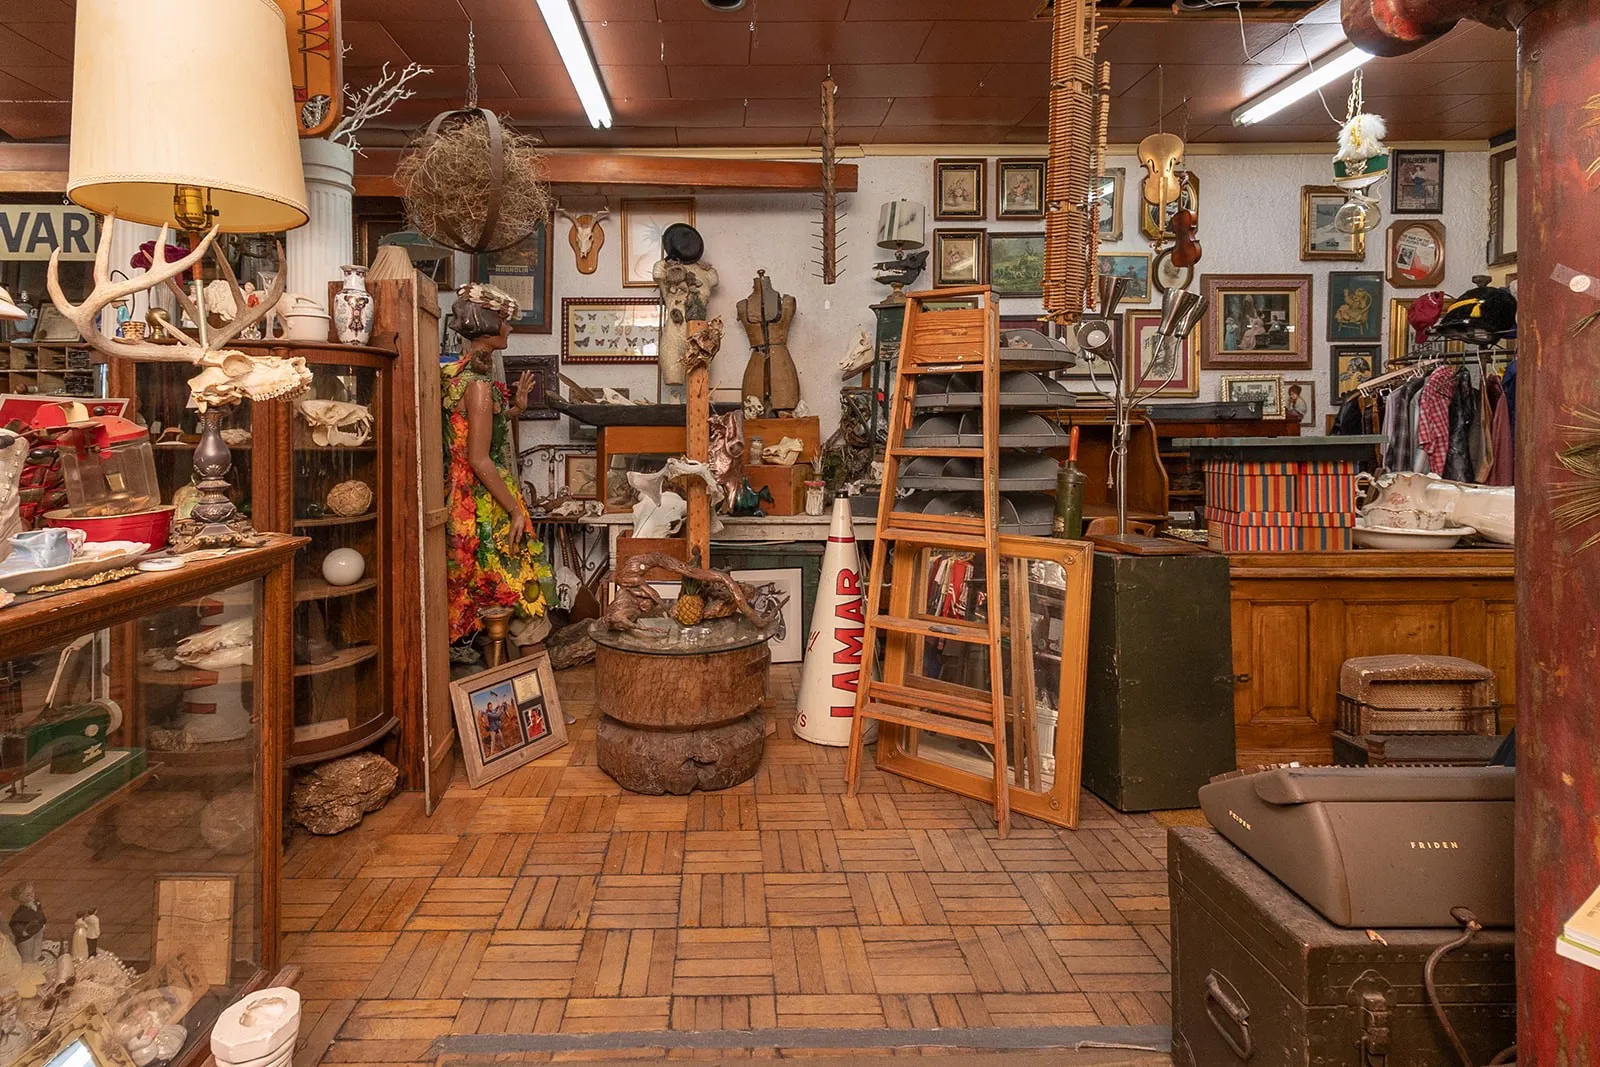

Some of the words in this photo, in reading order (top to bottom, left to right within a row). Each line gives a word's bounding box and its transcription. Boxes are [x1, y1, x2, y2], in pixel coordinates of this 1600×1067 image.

[0, 212, 103, 253] VAR
[1228, 809, 1251, 831] FRIDEN
[1410, 841, 1459, 849] FRIDEN
